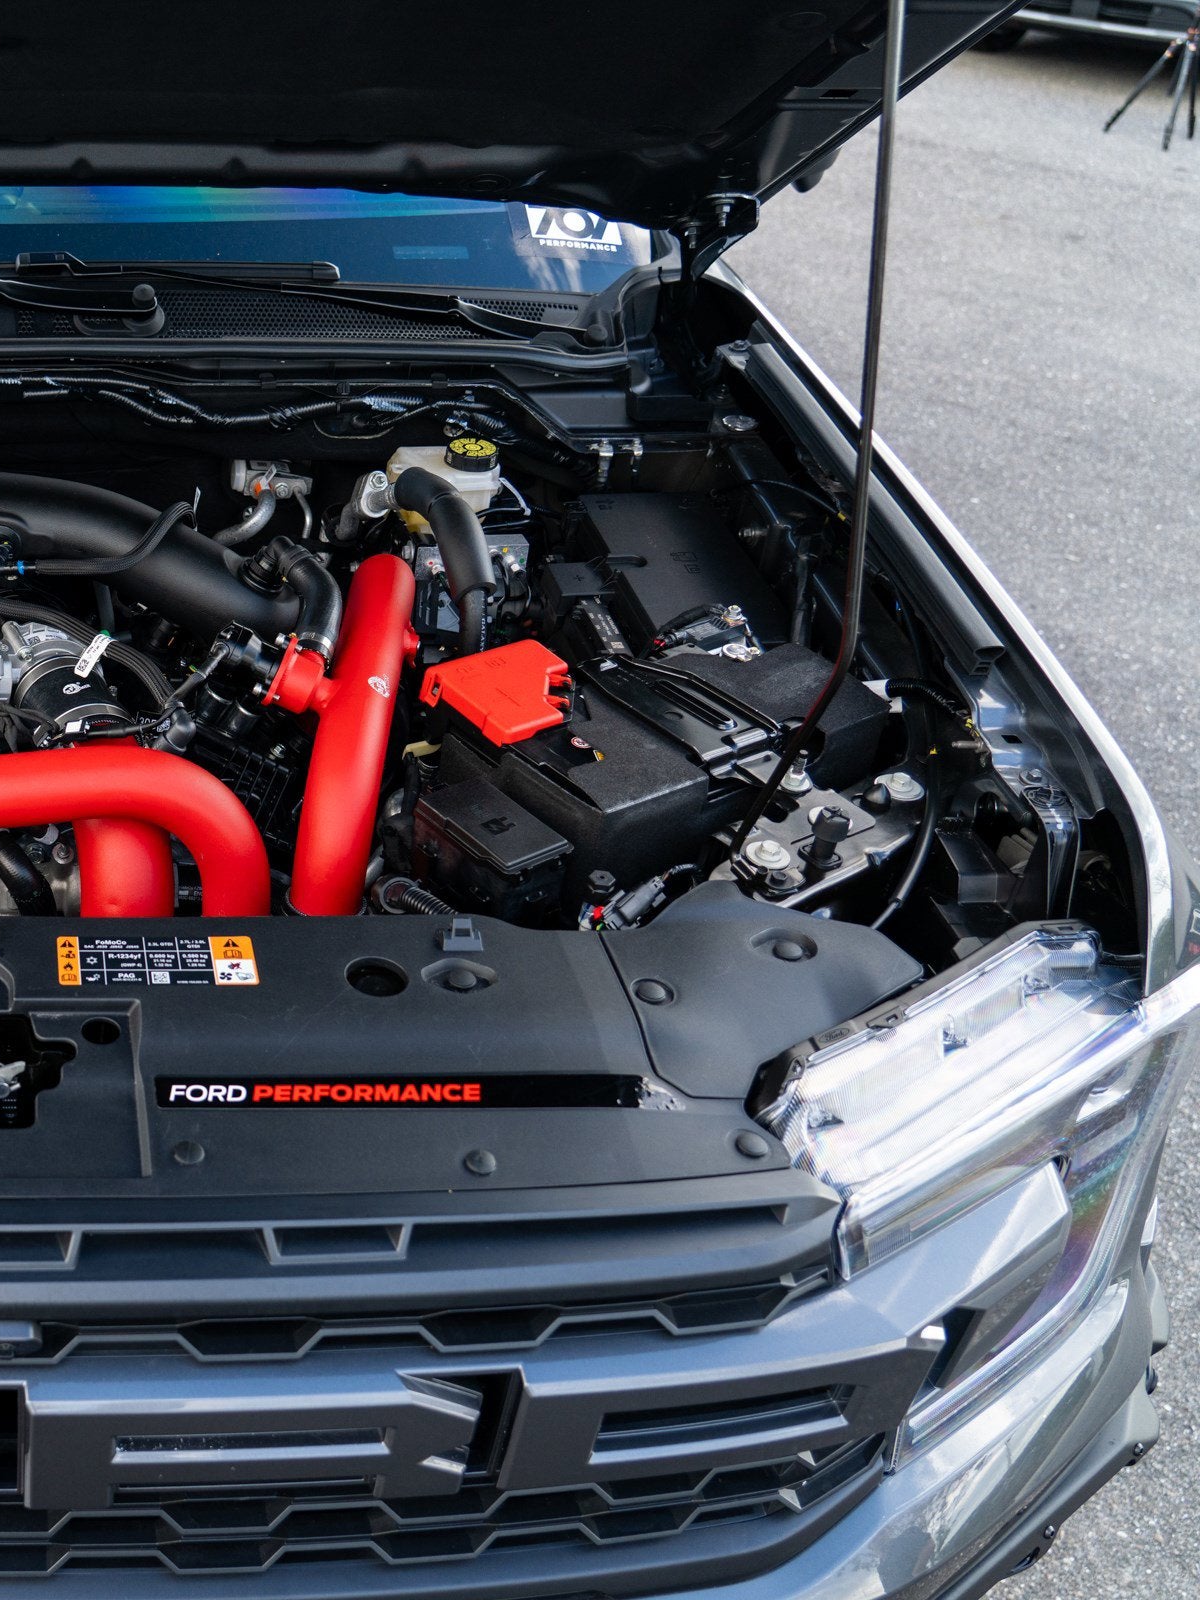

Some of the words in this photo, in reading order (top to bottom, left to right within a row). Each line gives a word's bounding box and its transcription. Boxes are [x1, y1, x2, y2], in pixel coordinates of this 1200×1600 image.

[539, 239, 618, 252] PERFORMANCE
[169, 1084, 248, 1102] FORD
[253, 1084, 482, 1102] PERFORMANCE
